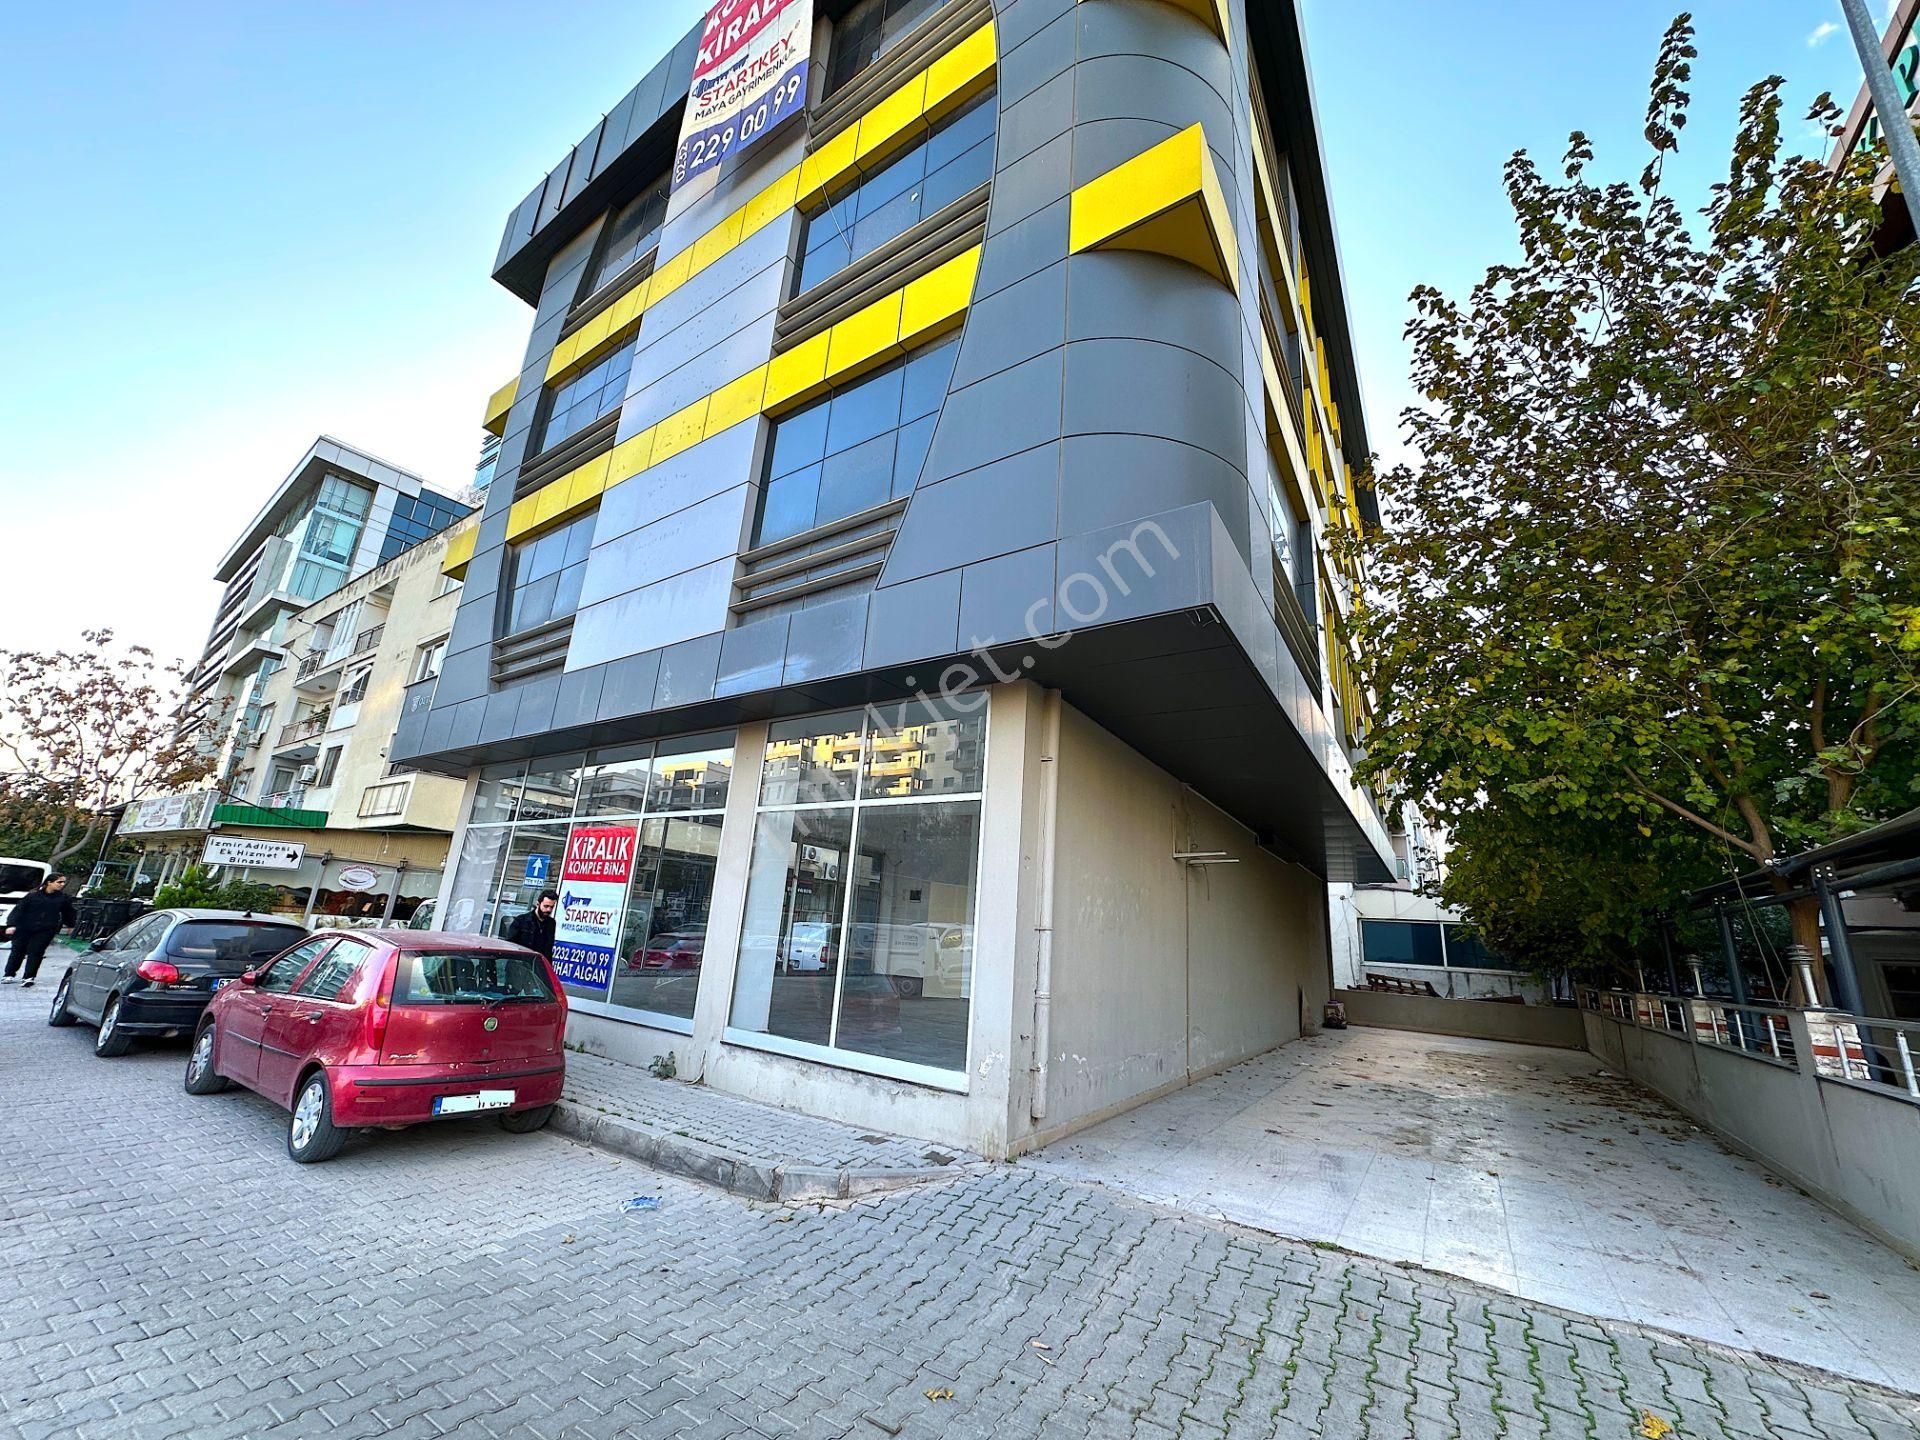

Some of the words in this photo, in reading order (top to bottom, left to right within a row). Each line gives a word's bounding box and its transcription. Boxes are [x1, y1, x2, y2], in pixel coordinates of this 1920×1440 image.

[700, 31, 793, 107] STARTKEY
[695, 100, 726, 120] MAYA
[690, 127, 734, 169] 229
[740, 104, 767, 141] 00
[774, 75, 800, 114] 99
[236, 850, 278, 859] Hizmet
[567, 861, 602, 875] KOMPLE
[565, 908, 613, 926] STARTKEY
[570, 948, 586, 963] 229
[586, 951, 598, 965] 00
[599, 953, 610, 967] 99
[573, 965, 607, 984] ALGAN
